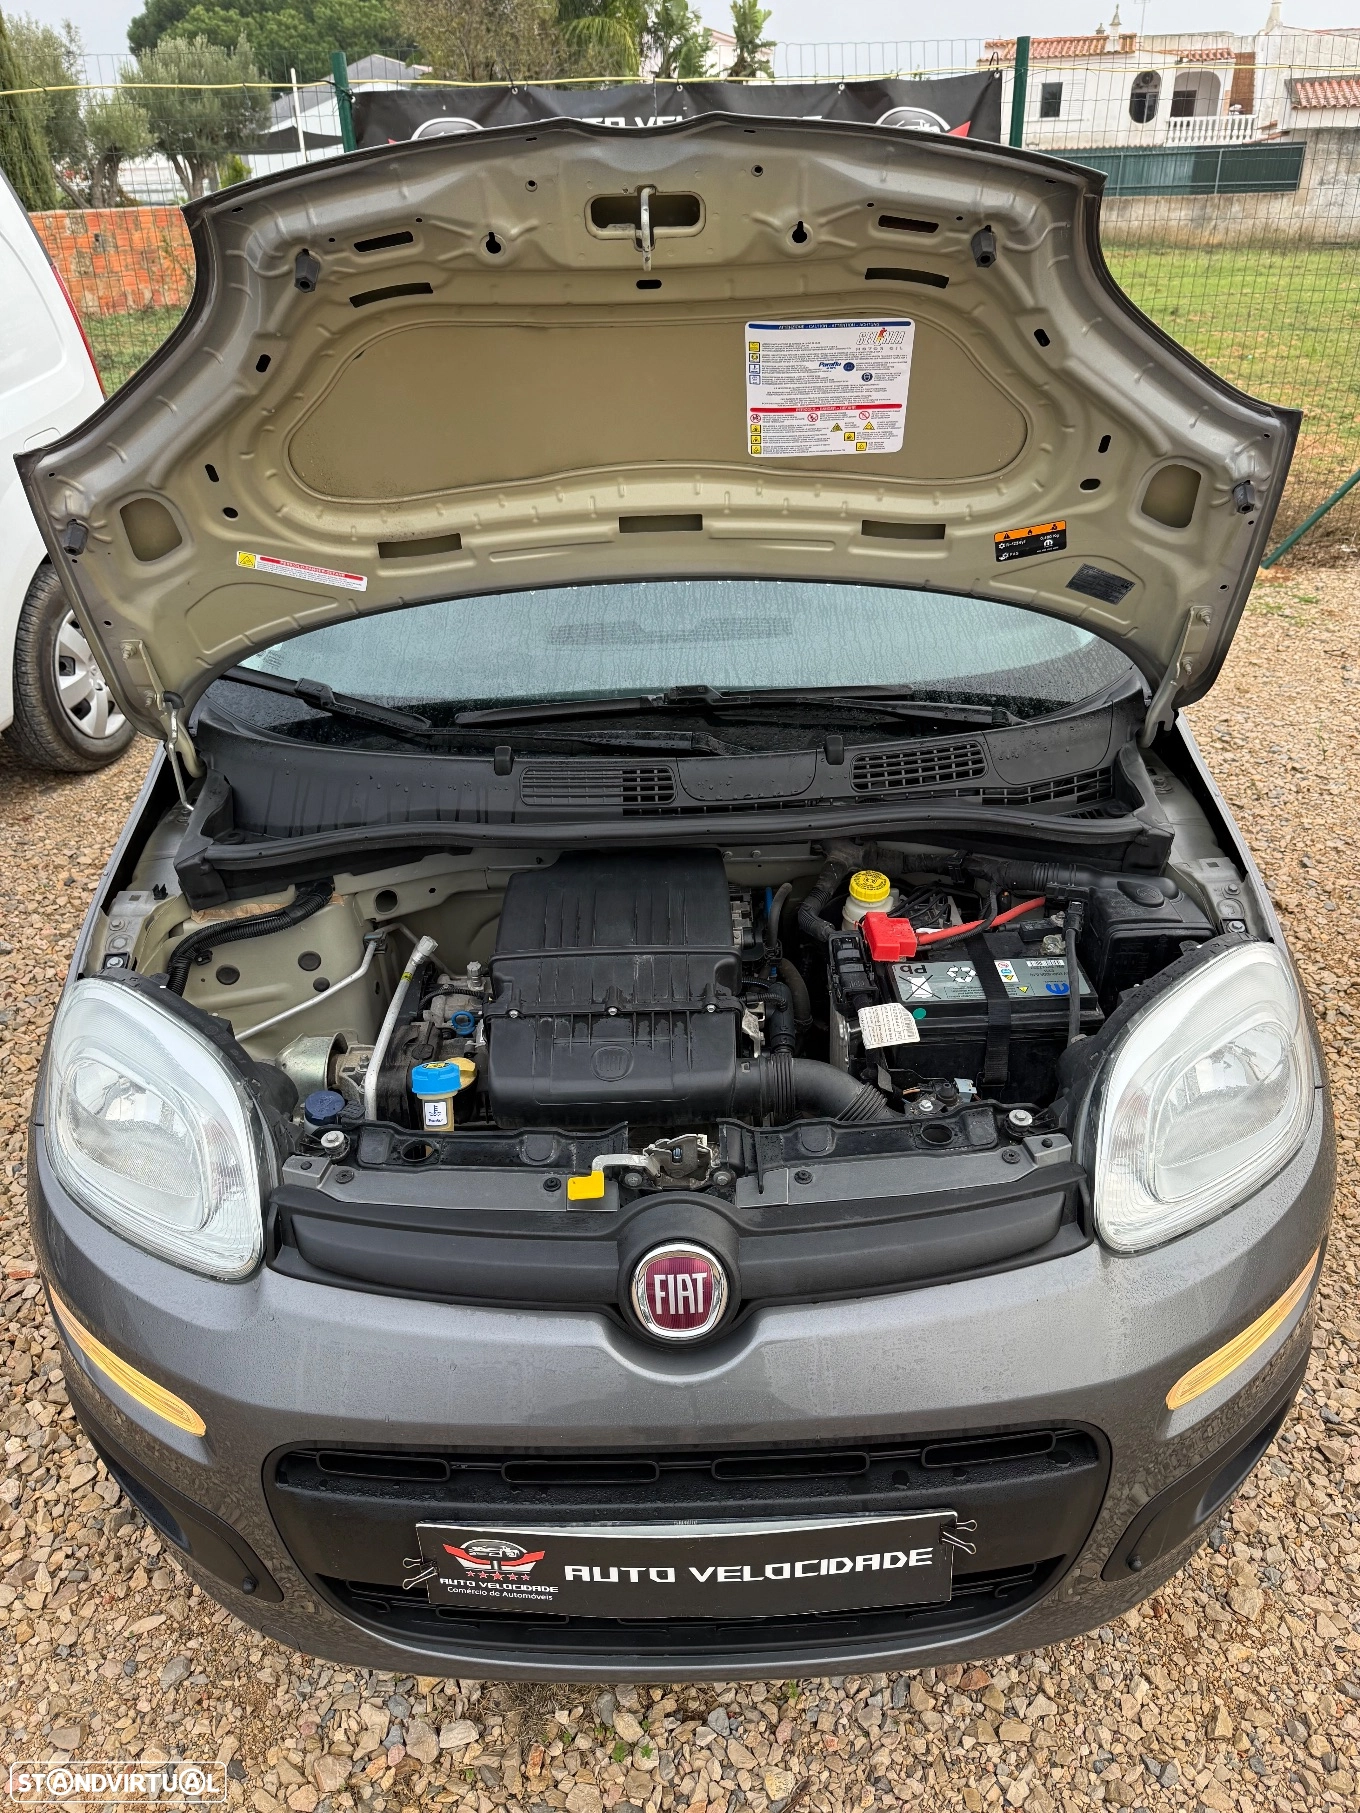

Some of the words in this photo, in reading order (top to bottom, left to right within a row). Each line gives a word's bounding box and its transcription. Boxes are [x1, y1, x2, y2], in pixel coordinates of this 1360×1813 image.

[900, 964, 928, 975] Pb
[653, 1272, 708, 1315] FIAT
[564, 1565, 676, 1583] AUTO
[688, 1547, 934, 1583] VELOCIDADE
[440, 1578, 476, 1587] AUTO
[478, 1581, 559, 1593] VELOCIDADE
[447, 1586, 488, 1596] Comércio
[502, 1591, 553, 1601] Automóveis
